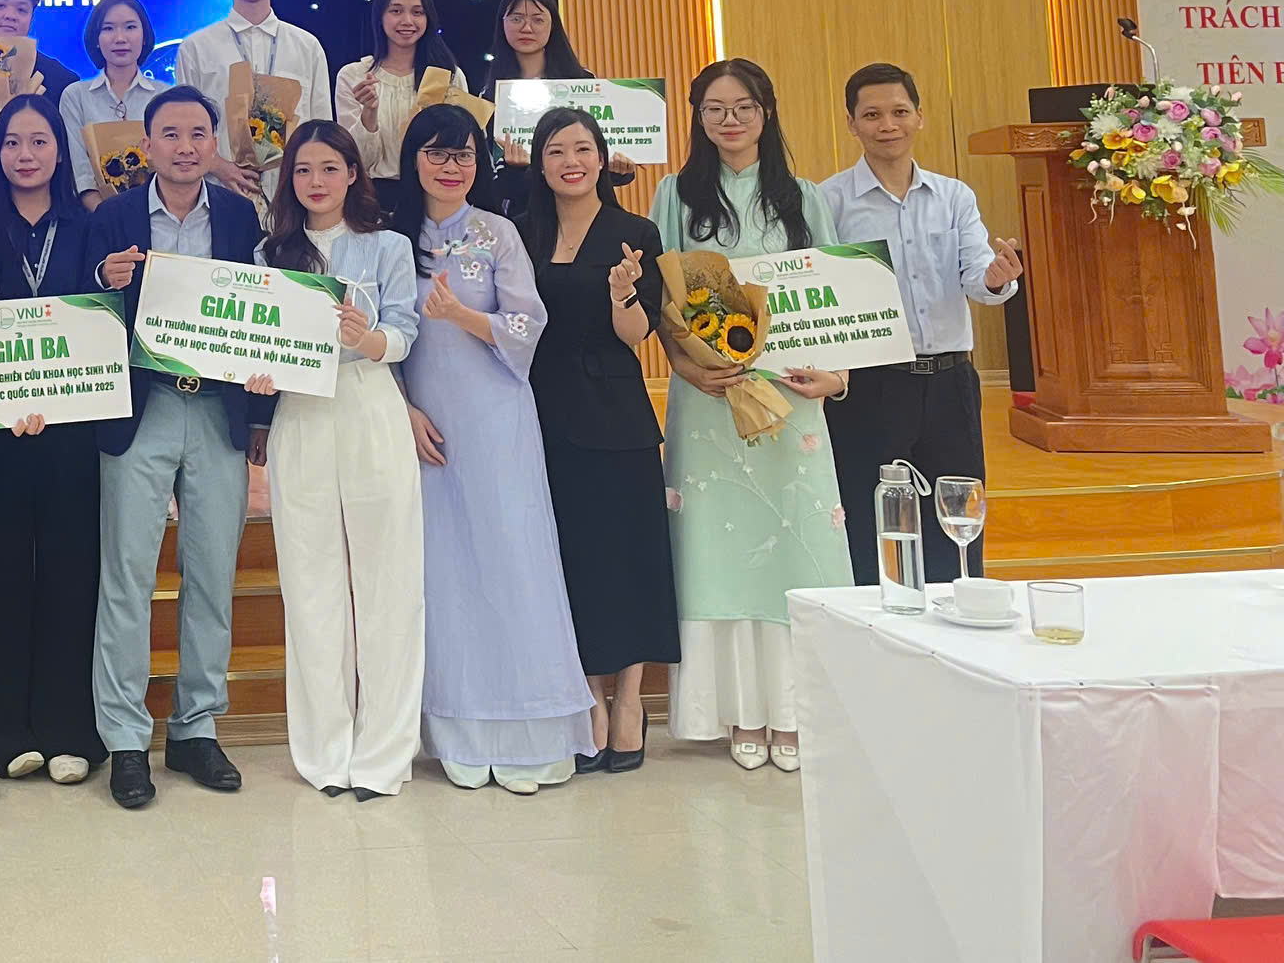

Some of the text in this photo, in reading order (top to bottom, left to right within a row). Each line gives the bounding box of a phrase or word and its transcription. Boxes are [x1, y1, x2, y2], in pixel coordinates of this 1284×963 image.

[1179, 0, 1281, 29] TRÁCH
[1197, 55, 1264, 84] TIÊN
[571, 85, 594, 93] VNU
[589, 106, 614, 120] BA
[775, 259, 803, 272] VNU
[235, 272, 262, 285] VNU
[201, 293, 280, 327] GIẢI BA
[766, 284, 838, 314] IẢI BA
[17, 307, 43, 319] VNU
[794, 319, 811, 331] CỨU
[813, 318, 836, 328] KHOA
[838, 316, 856, 326] HỌC
[858, 312, 878, 323] SINH
[880, 308, 899, 320] VIÊN
[146, 316, 162, 327] GIẢI
[199, 326, 228, 337] NGHIÊN
[230, 330, 247, 341] CỨU
[249, 334, 271, 344] KHOA
[274, 337, 291, 348] HỌC
[294, 341, 313, 351] SINH
[316, 343, 333, 354] VIÊN
[762, 327, 892, 352] ỌC QUỐC GIA HÀ NỘI NĂM 2025
[41, 336, 69, 359] BA
[156, 333, 321, 368] CẤP ĐẠI HỌC QUỐC GIA HÀ NỘI NĂM 2025
[25, 369, 41, 381] CỨU
[43, 369, 64, 379] KHOA
[67, 367, 83, 378] HỌC
[86, 366, 104, 375] SINH
[106, 362, 123, 374] VIÊN
[7, 387, 29, 400] QUỐC
[32, 388, 45, 397] GIA
[47, 384, 58, 396] HÀ
[60, 383, 74, 396] NỘI
[76, 382, 93, 393] NĂM
[95, 382, 114, 392] 2025
